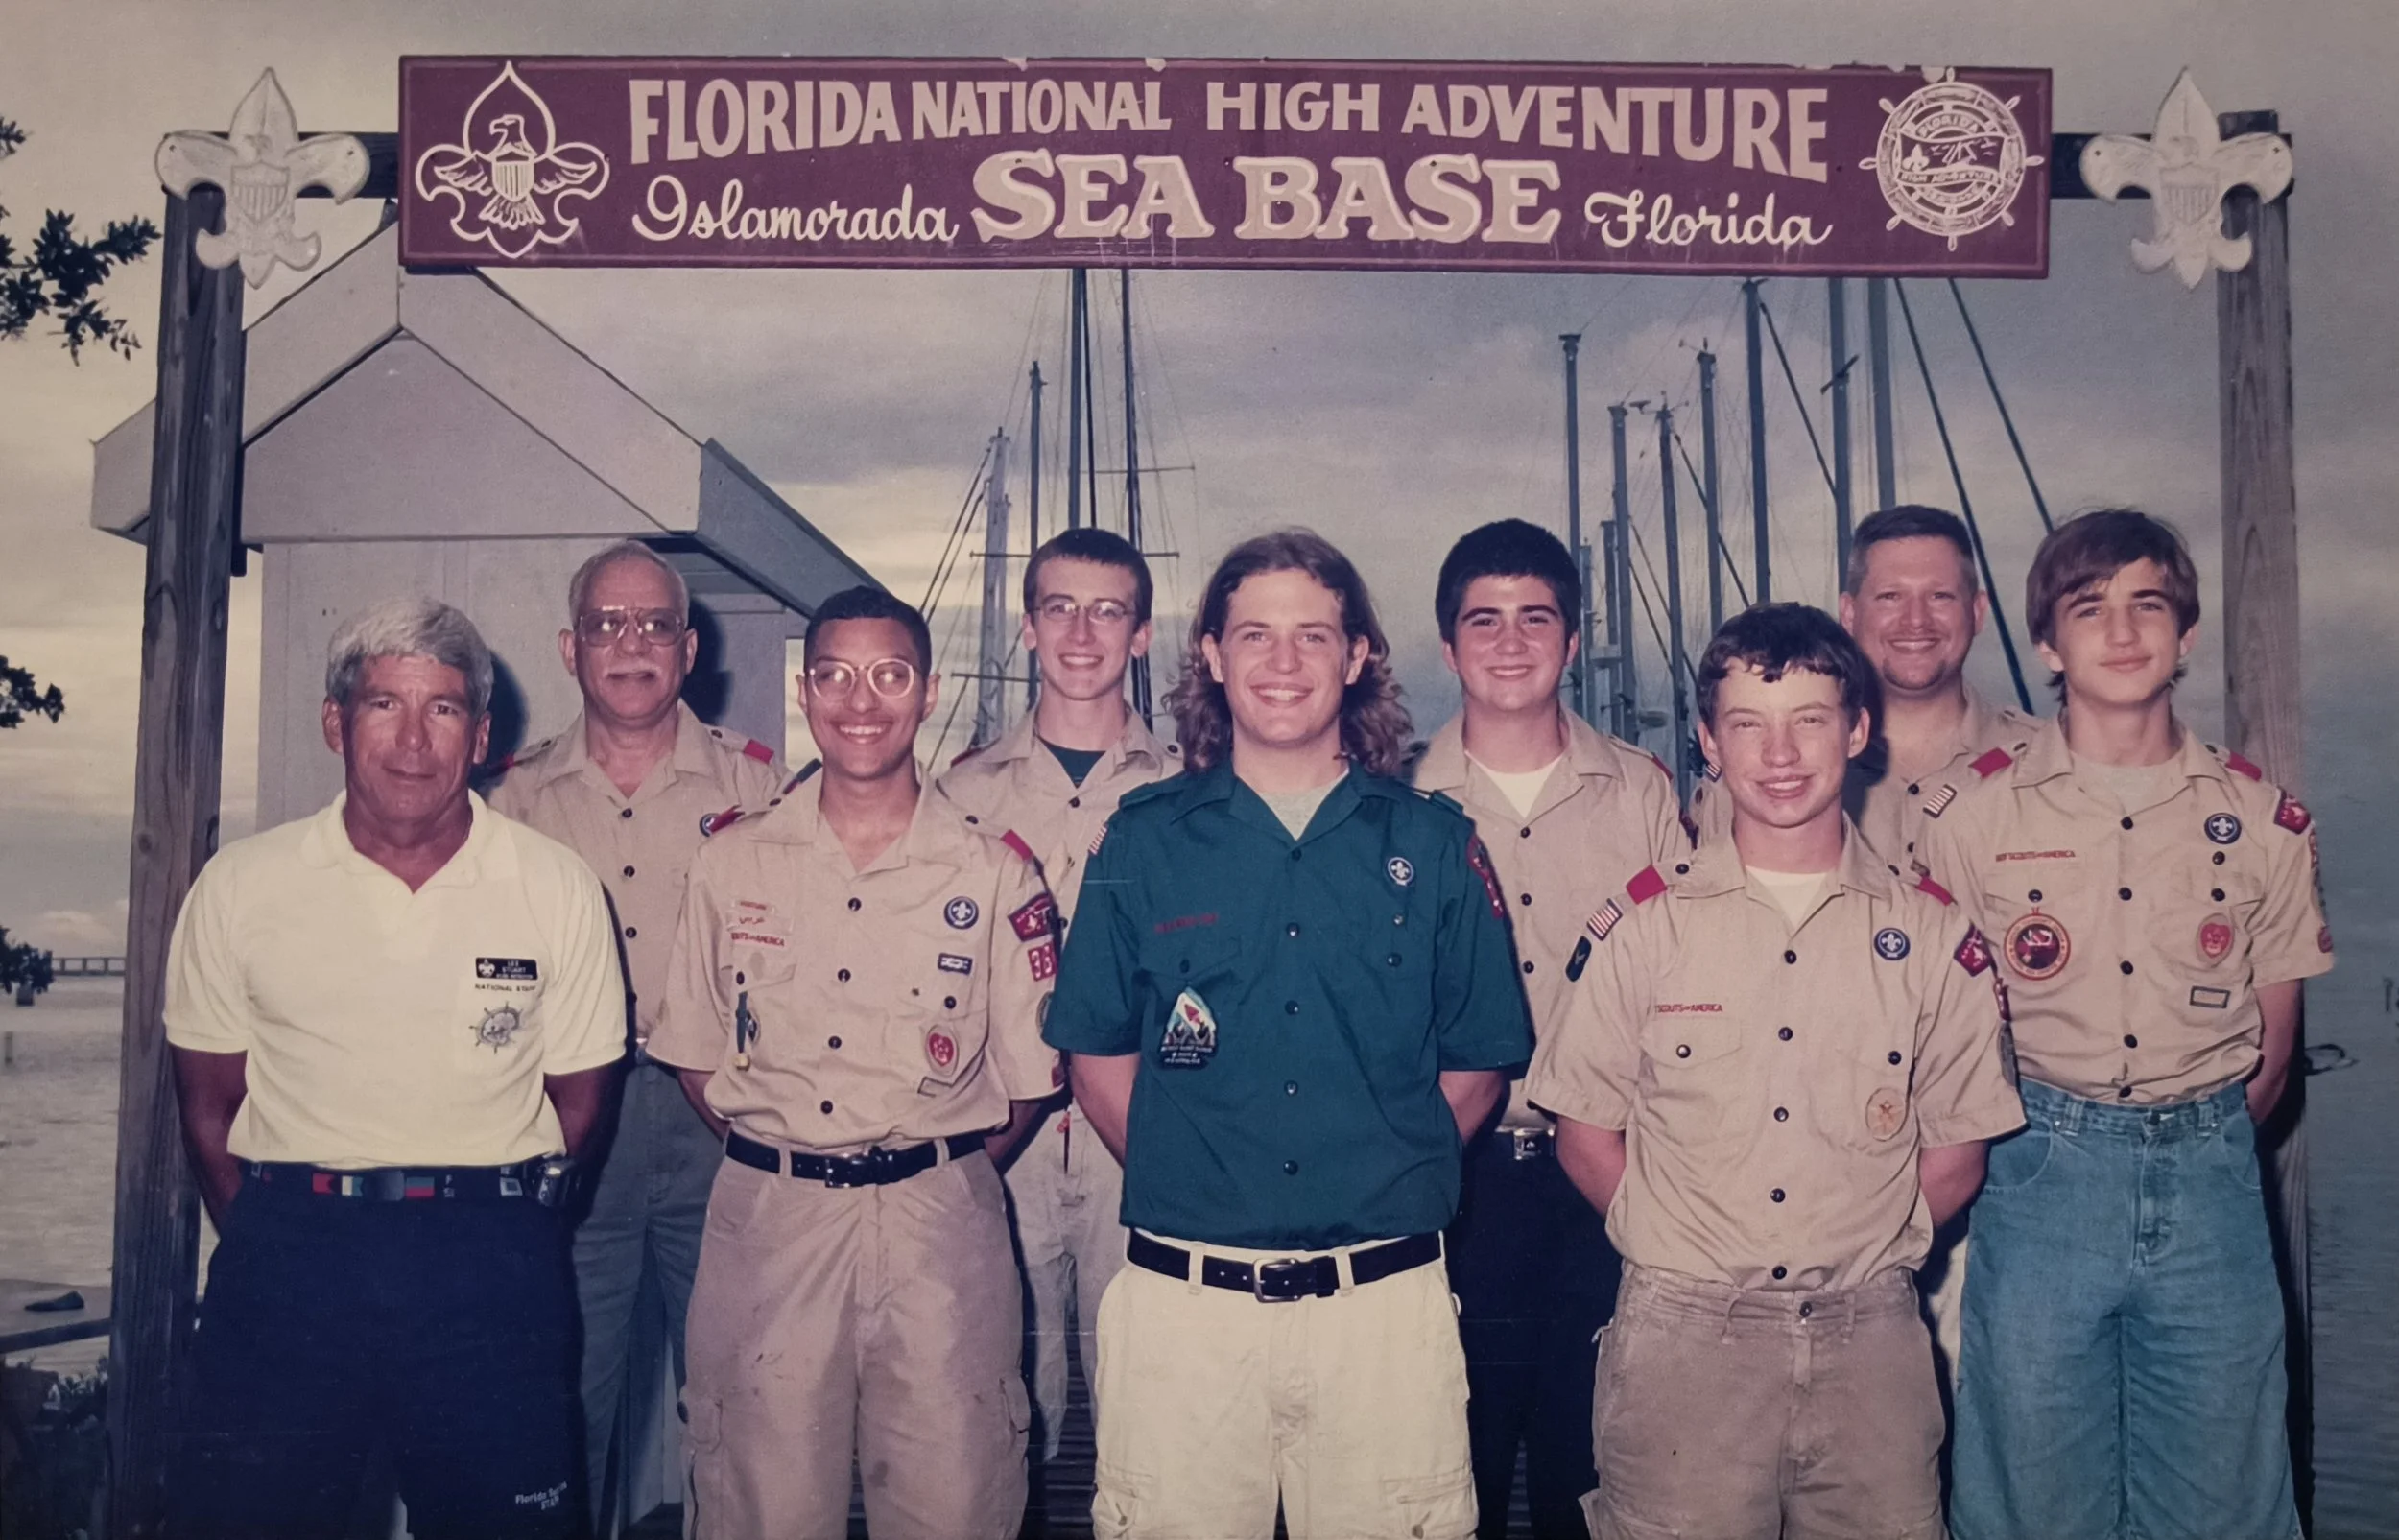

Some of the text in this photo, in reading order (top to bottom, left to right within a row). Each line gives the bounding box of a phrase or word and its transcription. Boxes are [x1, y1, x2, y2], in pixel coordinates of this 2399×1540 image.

[629, 79, 1828, 183] FLORIDA NATIONAL HIGH ADVENTURE
[631, 148, 1834, 248] Islamorada SEA BASE Florida
